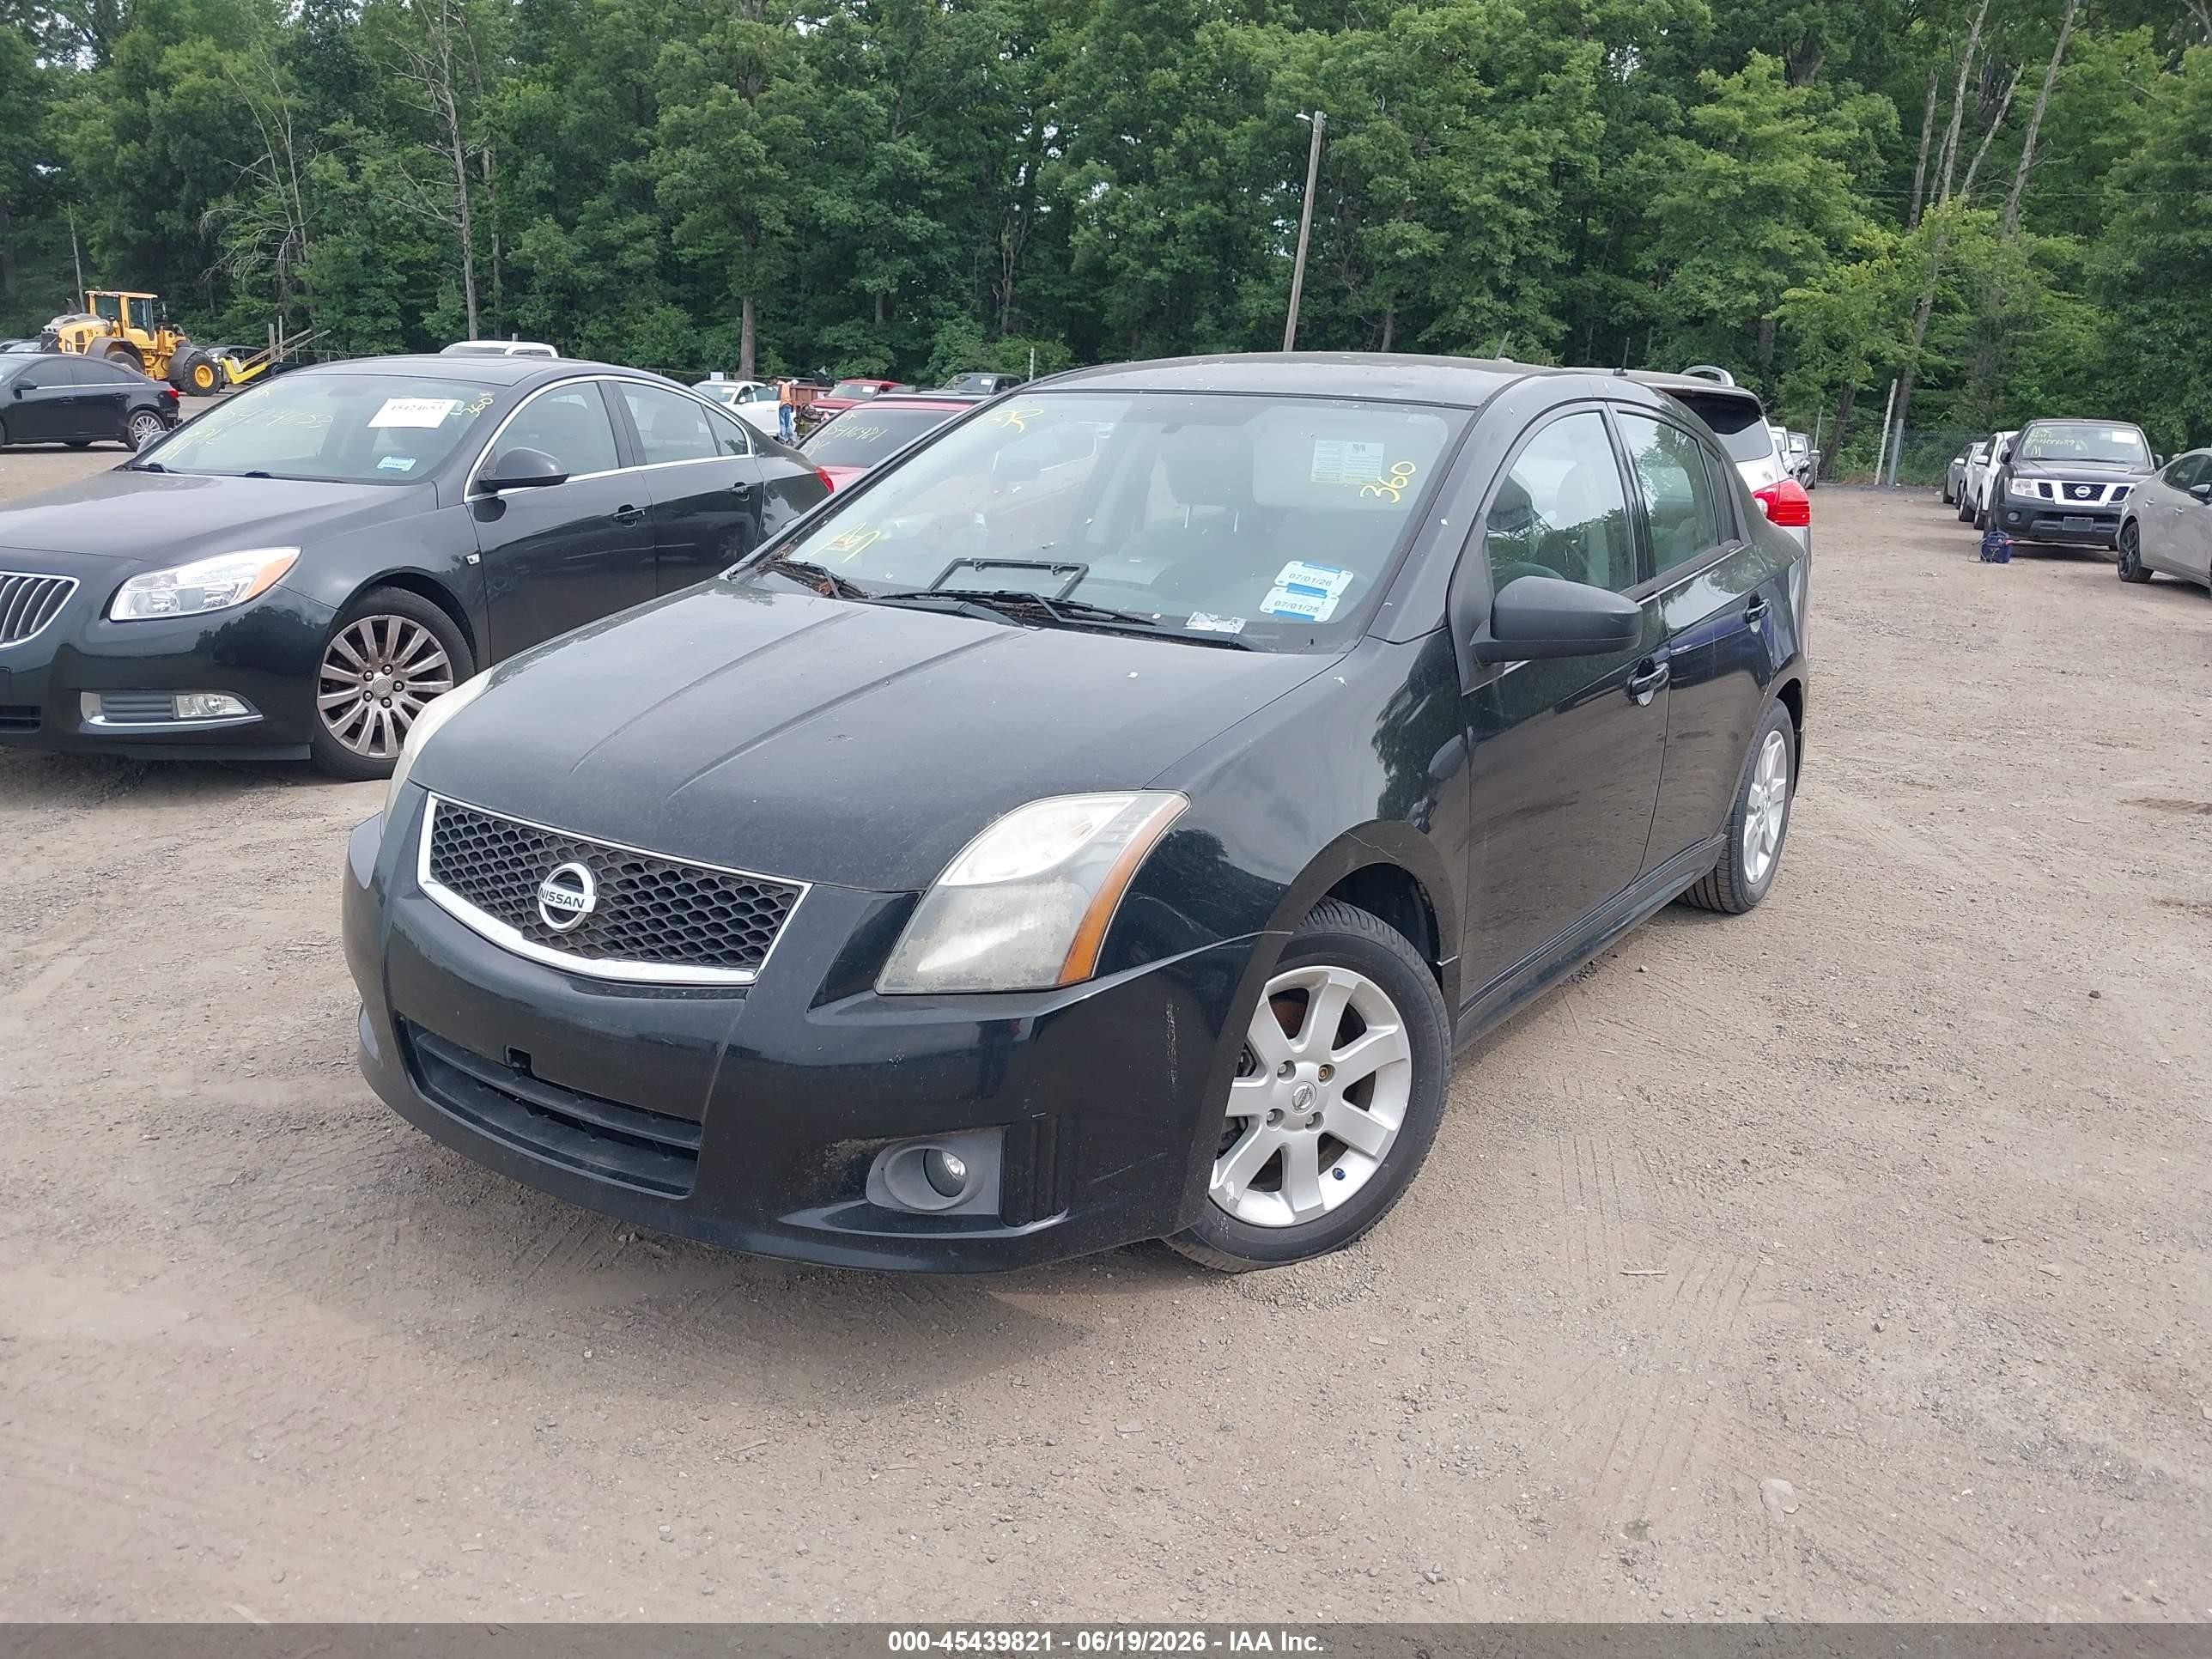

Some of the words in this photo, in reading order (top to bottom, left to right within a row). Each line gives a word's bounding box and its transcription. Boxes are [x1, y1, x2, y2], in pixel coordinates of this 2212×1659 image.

[1359, 460, 1416, 504] 360
[1288, 573, 1334, 587] 07/01/26
[1273, 600, 1320, 614] 07/01/25
[538, 887, 586, 909] NISSAN
